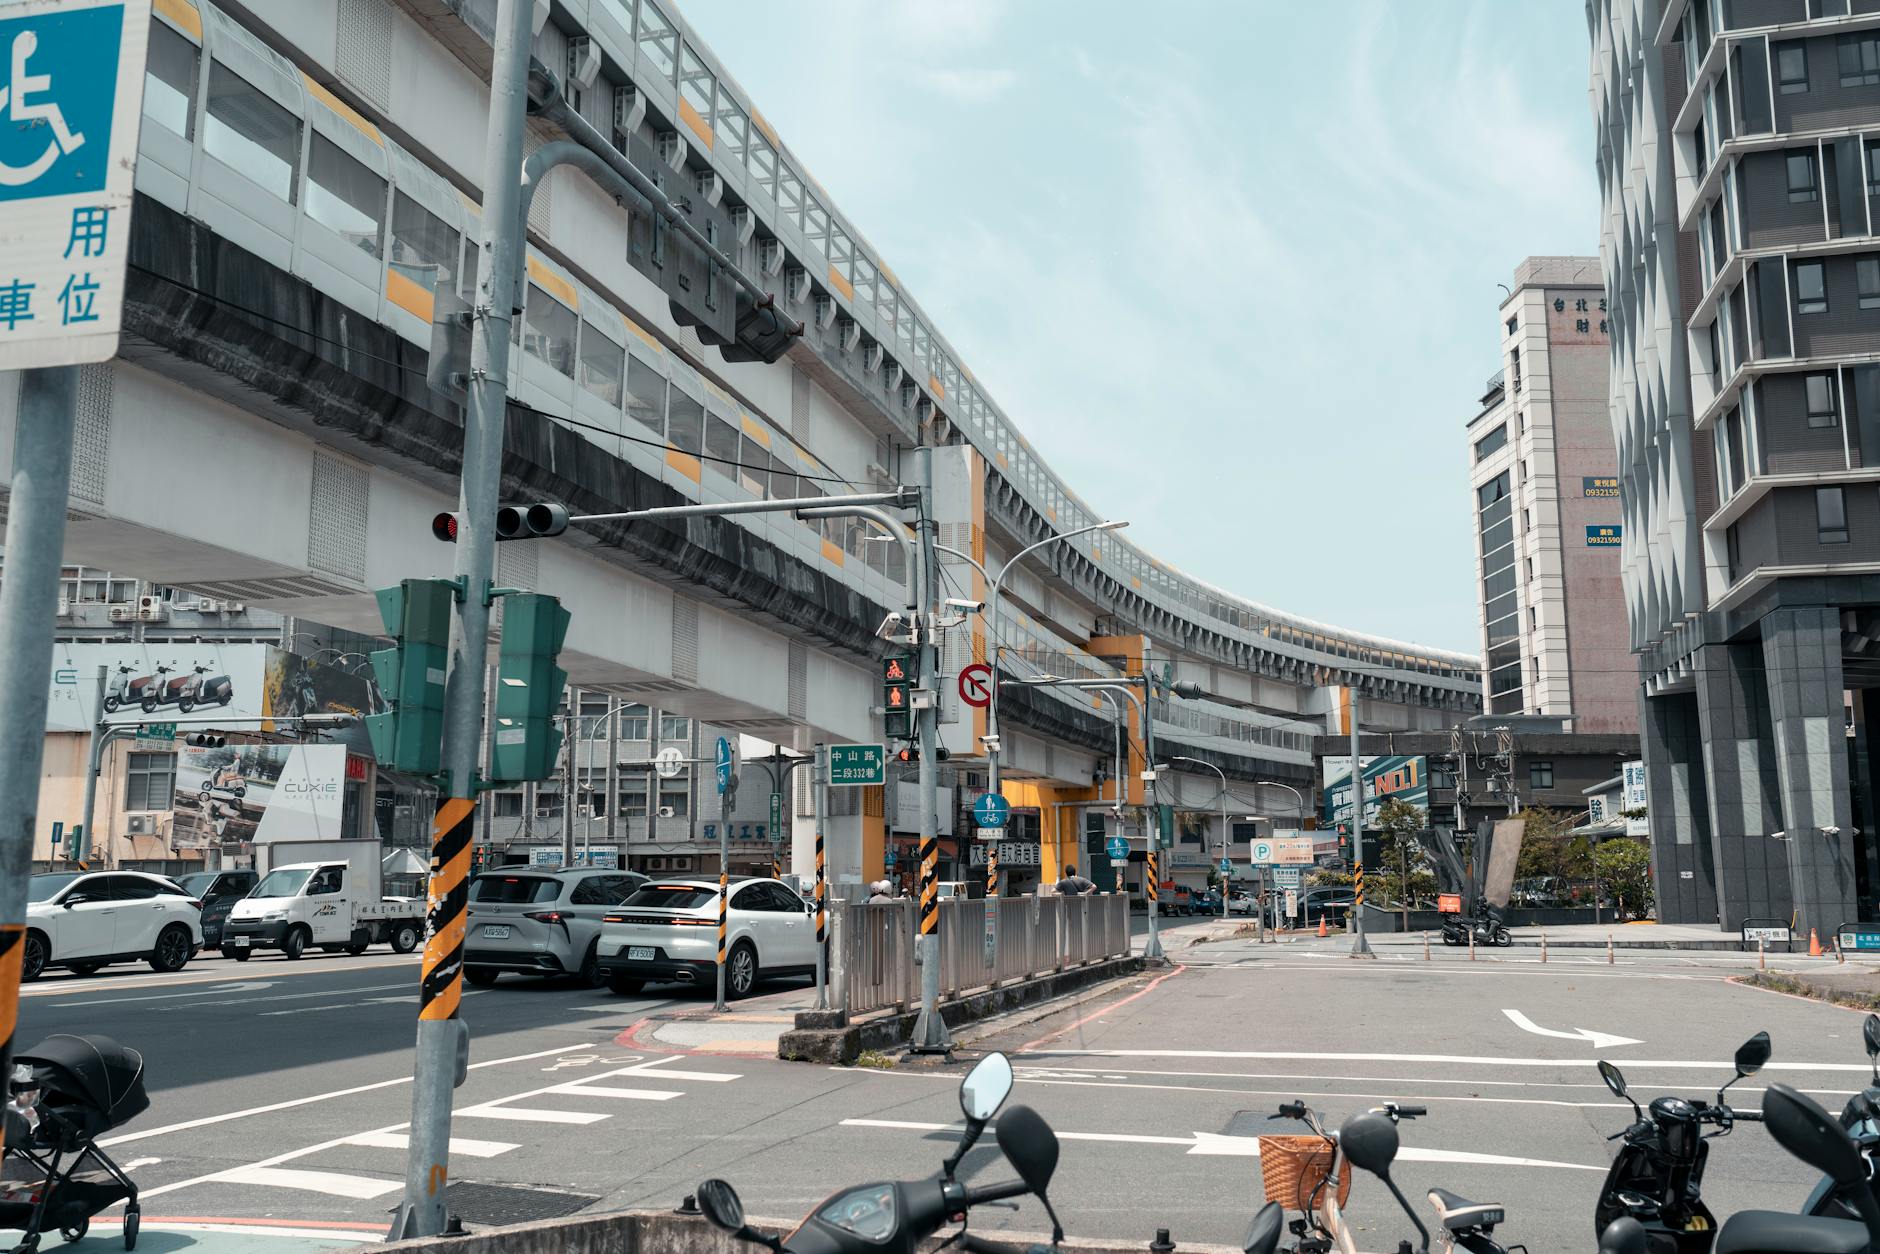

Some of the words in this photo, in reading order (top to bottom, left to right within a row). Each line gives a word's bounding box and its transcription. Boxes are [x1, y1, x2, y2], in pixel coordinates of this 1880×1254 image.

[63, 206, 110, 260] 用
[0, 273, 101, 331] 車位
[832, 750, 875, 762] 中山路
[832, 768, 876, 779] 二段332巷
[1375, 758, 1418, 797] NO.1
[972, 842, 1040, 864] 大都男女時尚會
